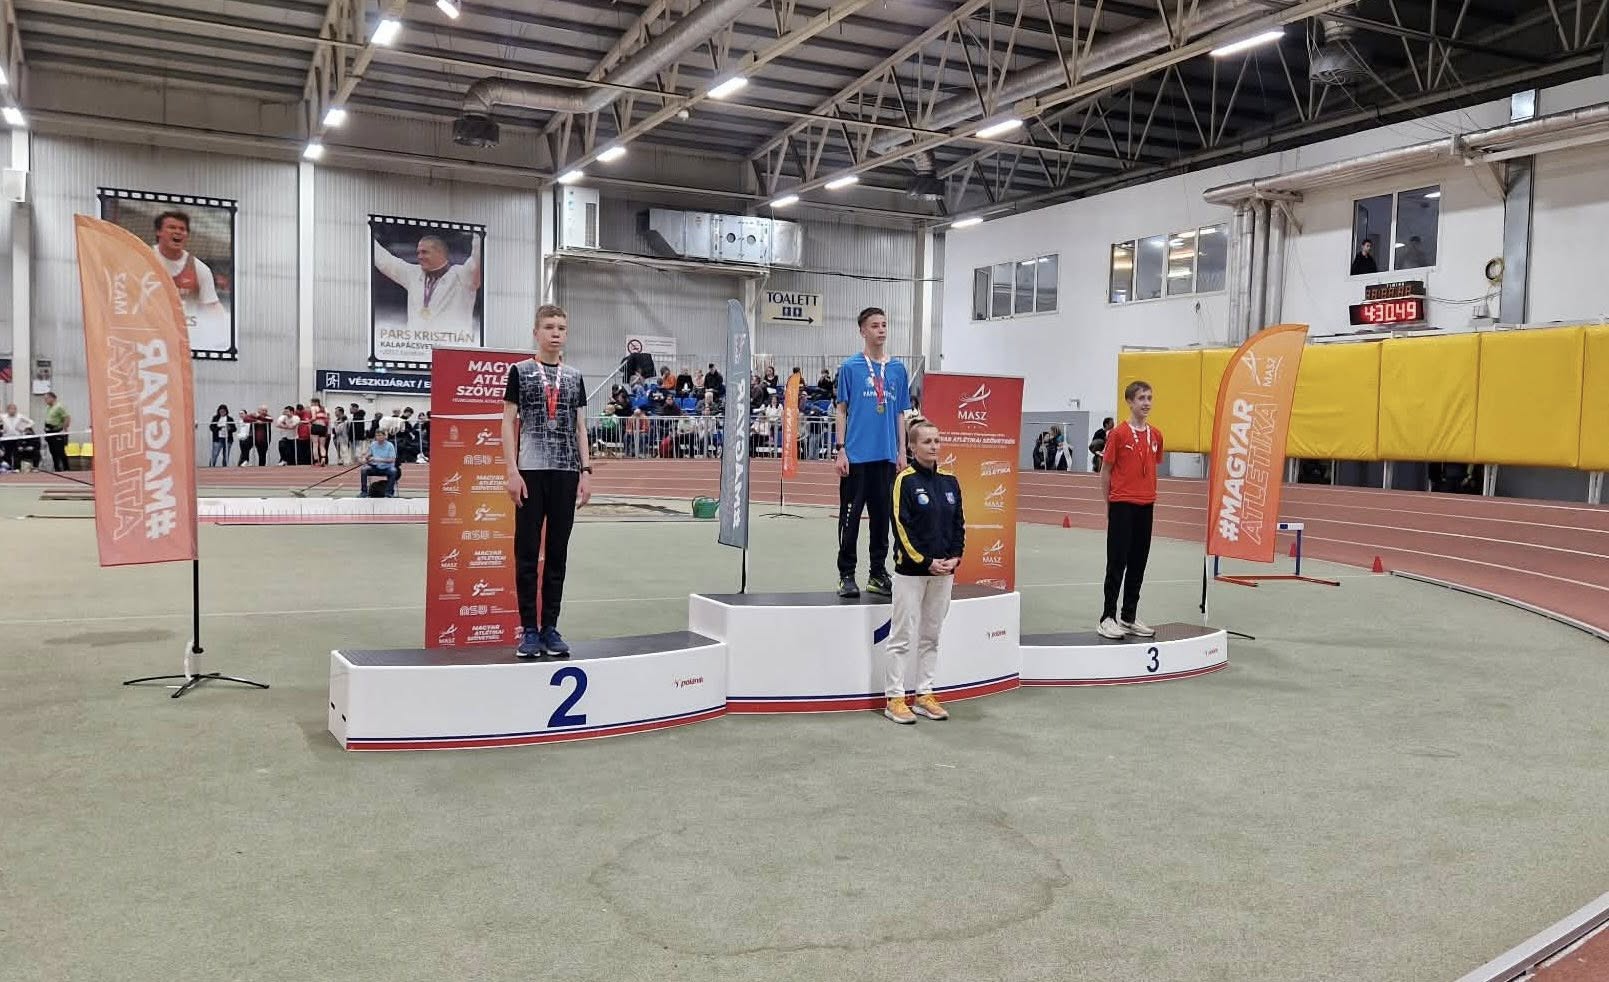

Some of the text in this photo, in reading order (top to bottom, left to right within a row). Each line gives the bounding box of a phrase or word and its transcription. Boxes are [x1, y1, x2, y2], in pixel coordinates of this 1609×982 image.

[767, 291, 819, 306] TOALETT
[380, 329, 475, 344] PARS KRISZTIÁN
[381, 341, 432, 350] KALAPÁCSVET
[468, 361, 509, 373] MAGY
[348, 376, 416, 388] VÉSZKIJÁRAT
[456, 384, 507, 397] SZÖVET
[957, 410, 987, 420] MASZ
[1219, 398, 1254, 541] #MAGYAR
[1147, 647, 1160, 672] 3
[547, 666, 588, 728] 2
